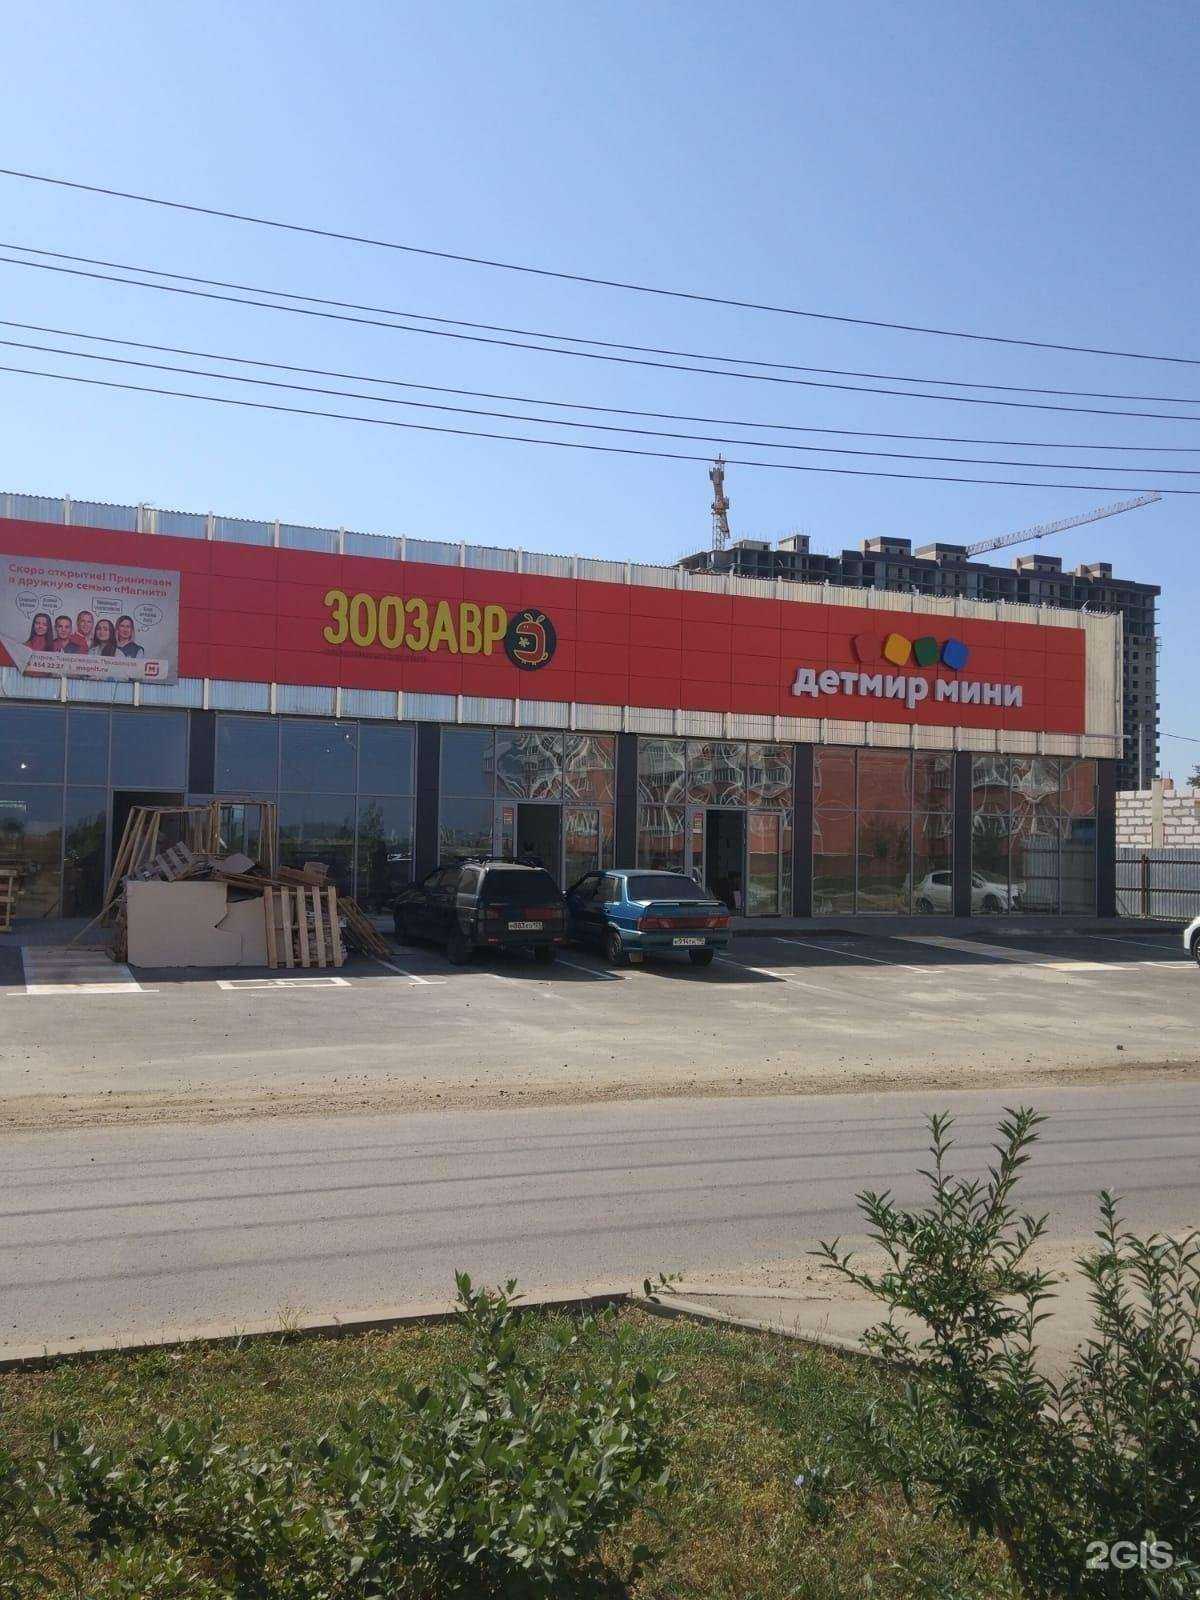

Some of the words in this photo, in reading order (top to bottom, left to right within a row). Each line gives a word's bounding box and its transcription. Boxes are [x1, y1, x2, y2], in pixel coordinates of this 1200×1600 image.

[9, 563, 45, 576] Скоро
[48, 568, 106, 581] открытие!
[109, 573, 173, 587] Принимаем
[18, 577, 74, 590] дружную
[76, 582, 112, 593] семью
[114, 585, 168, 598] «Магнит»
[323, 589, 508, 656] ЗООЗАВР
[792, 667, 929, 709] детмир
[935, 678, 1023, 708] мини
